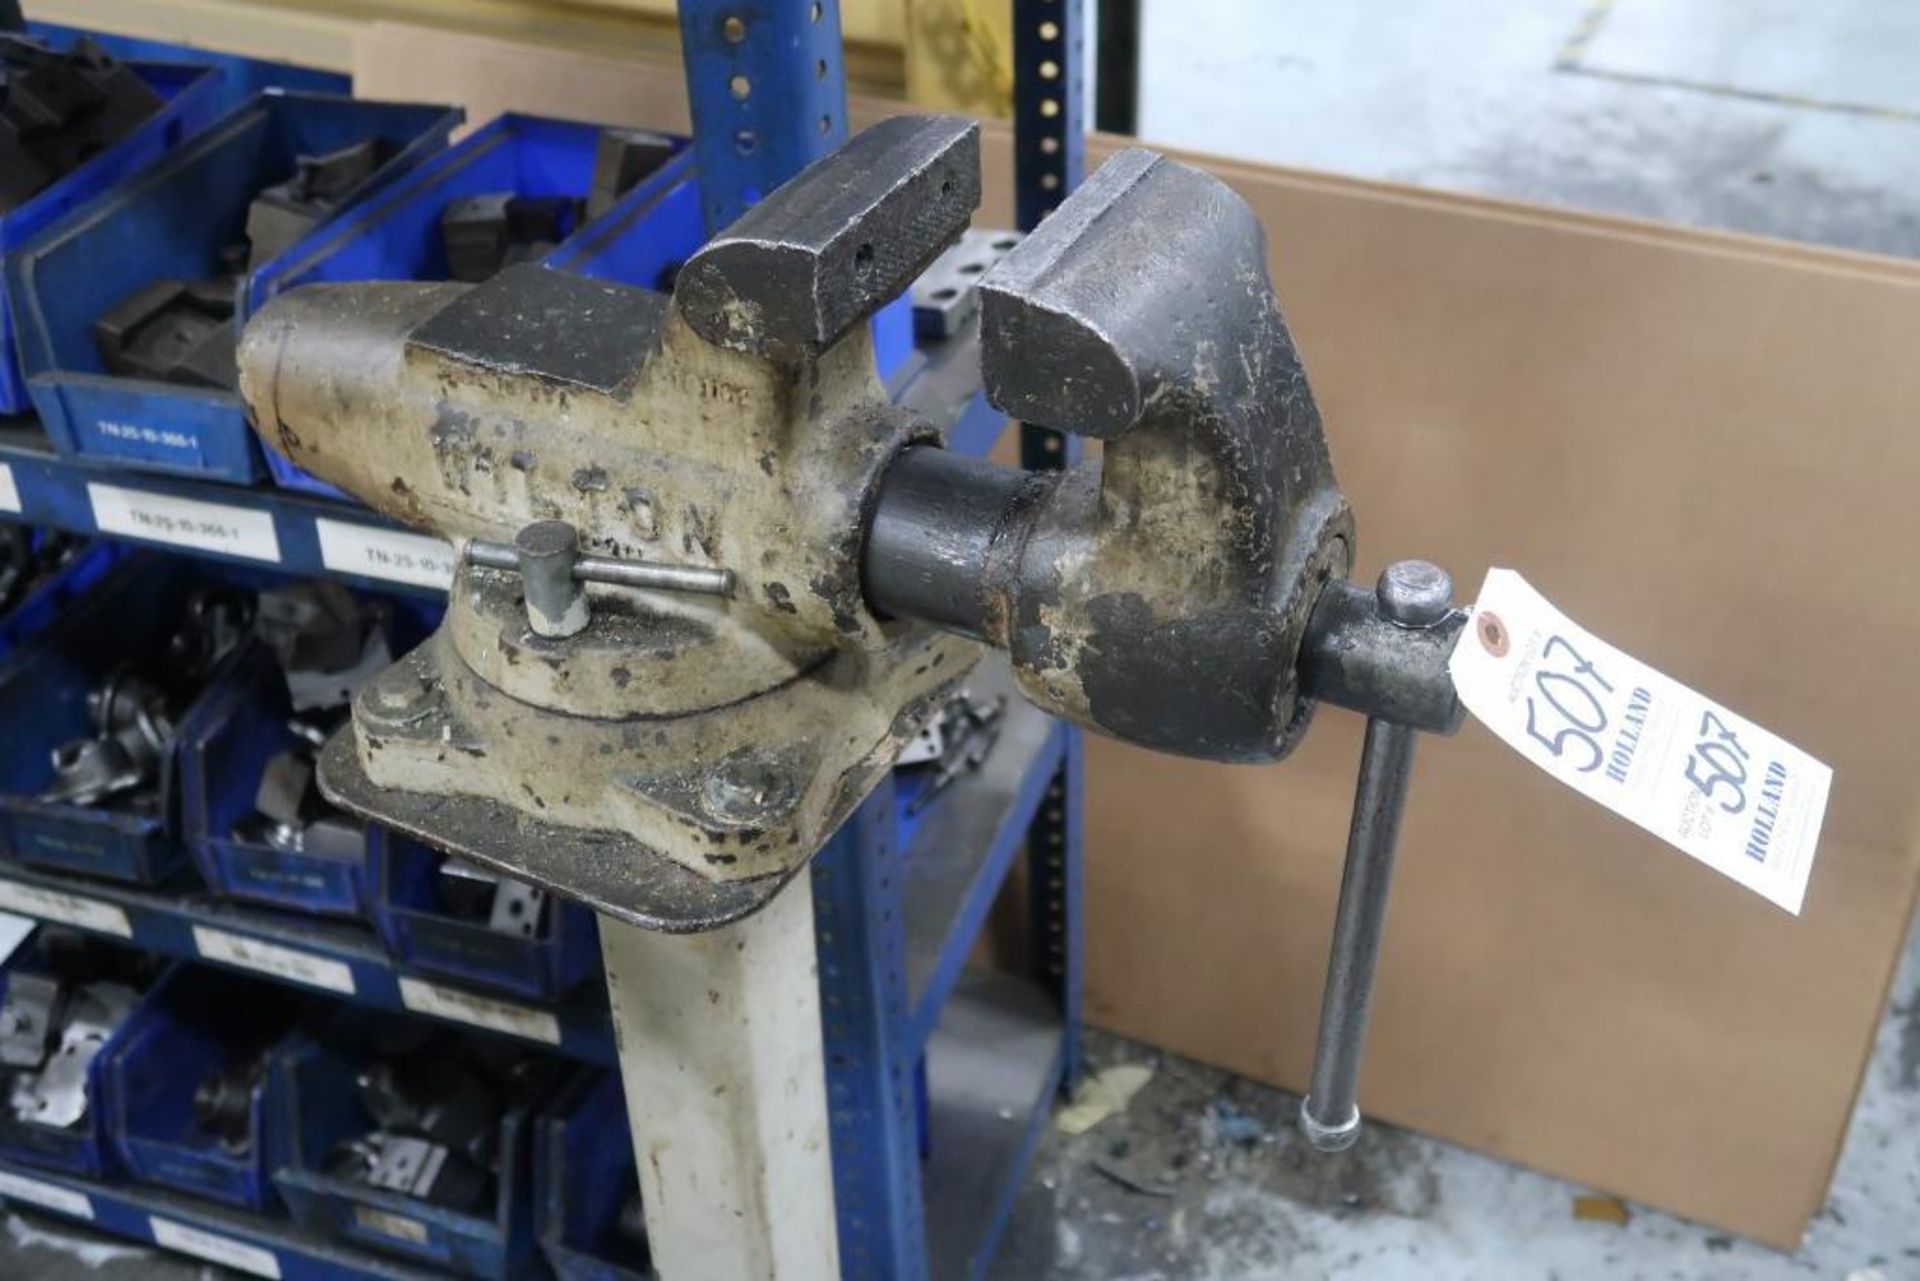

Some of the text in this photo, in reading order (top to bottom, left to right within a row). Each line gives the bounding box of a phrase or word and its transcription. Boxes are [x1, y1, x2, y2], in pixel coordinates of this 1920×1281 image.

[1527, 635, 1614, 772] 507
[1606, 687, 1651, 783] HOLLAND
[1685, 710, 1749, 813] 507
[1745, 761, 1787, 863] HOLLAND
